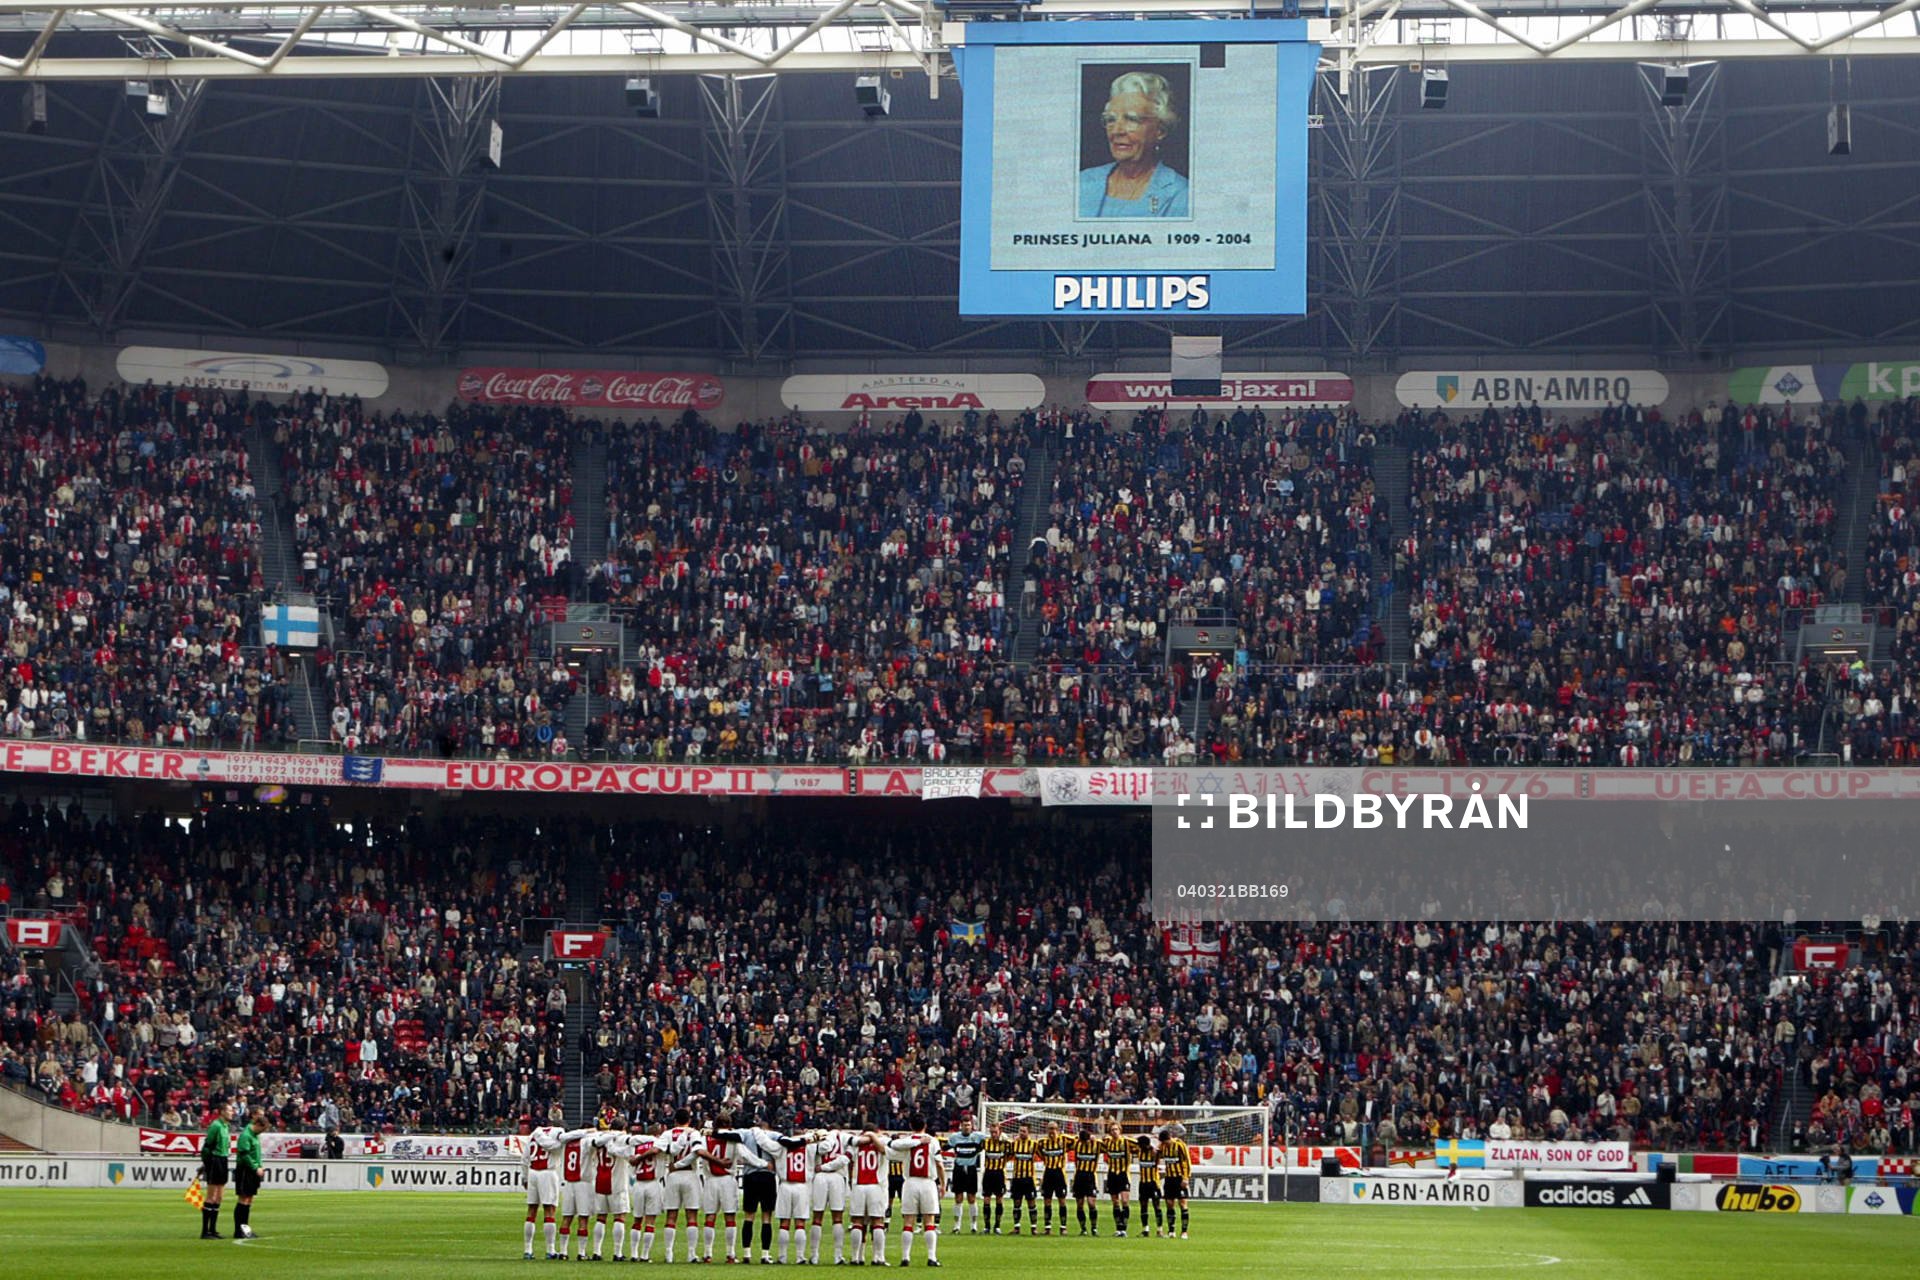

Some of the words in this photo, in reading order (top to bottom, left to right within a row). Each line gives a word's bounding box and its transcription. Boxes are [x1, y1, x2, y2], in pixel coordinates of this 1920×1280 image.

[1012, 233, 1078, 245] PRINSES
[1081, 233, 1152, 248] JULIANA
[1167, 233, 1200, 245] 1909
[1216, 233, 1252, 245] 2004
[1053, 274, 1210, 311] PHILIPS
[485, 372, 573, 402] Coca-Cola
[606, 376, 694, 405] Coca-Cola
[862, 376, 965, 388] AMSTERDAM
[1124, 380, 1316, 401] wwajax.nl
[51, 747, 186, 780] BEKER
[260, 765, 287, 774] 1972
[446, 764, 714, 793] EUROPACUP
[794, 778, 820, 787] 1987
[1439, 772, 1549, 798] 1976
[1654, 772, 1766, 799] UEFA
[1782, 771, 1871, 799] CUP
[930, 786, 971, 798] AJAX
[563, 934, 593, 956] F
[567, 1151, 578, 1171] 8
[787, 1152, 805, 1172] 18
[859, 1150, 877, 1171] 10
[914, 1149, 925, 1169] 6
[1546, 1149, 1574, 1161] SON
[1576, 1149, 1593, 1161] OF
[1597, 1149, 1624, 1161] GOD
[1539, 1187, 1615, 1205] adidas
[1722, 1187, 1796, 1211] hubo
